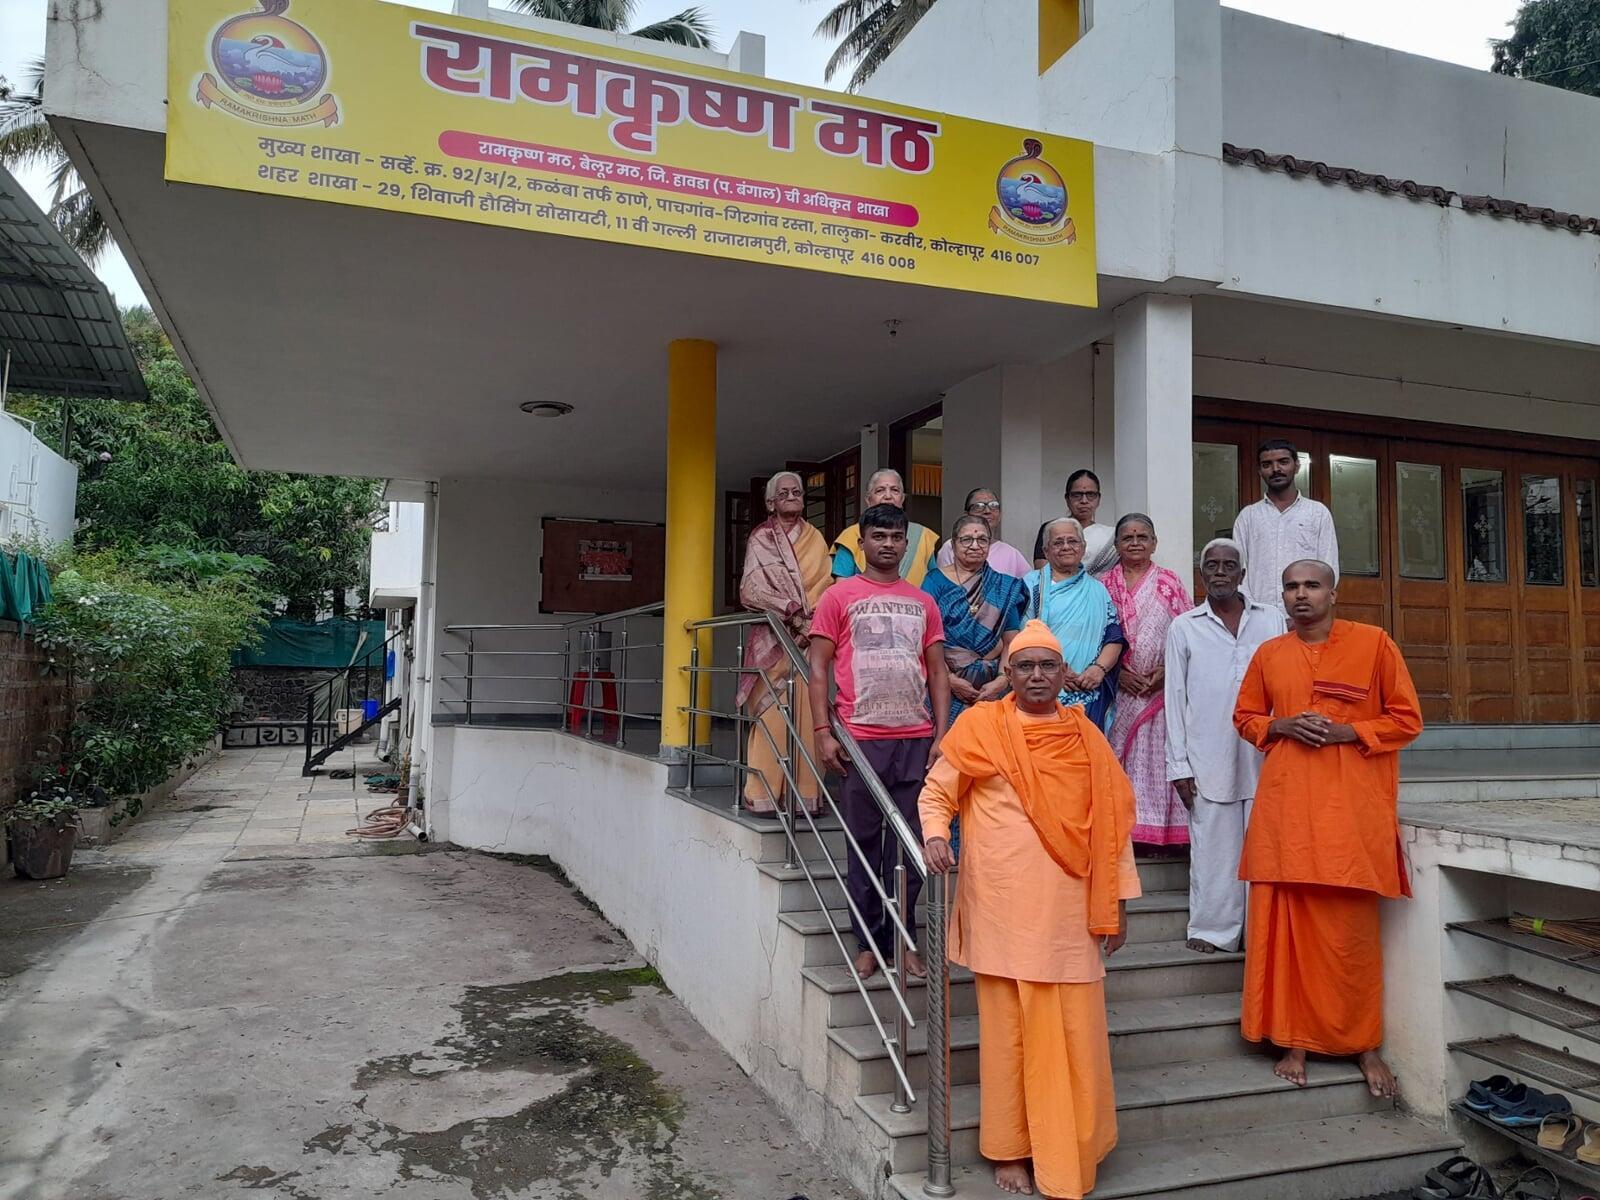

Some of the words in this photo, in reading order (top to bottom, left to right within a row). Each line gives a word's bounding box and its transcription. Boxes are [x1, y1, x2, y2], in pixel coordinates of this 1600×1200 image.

[219, 97, 289, 123] RAMAKRISHNA
[292, 111, 317, 123] MATH
[413, 24, 800, 153] रामकृष्ण
[811, 101, 939, 173] मठ
[257, 136, 306, 158] मुख्य
[310, 145, 360, 165] शाखा
[423, 161, 447, 178] क्र.
[452, 166, 522, 190] 92/अ/2,
[526, 177, 579, 198] कळंबा
[582, 185, 612, 202] तर्फ
[615, 191, 651, 211] ठाणे,
[782, 216, 817, 235] रस्ता,
[880, 231, 927, 251] करवीर,
[929, 237, 985, 262] कोल्हापूर
[990, 249, 1013, 263] 416
[1015, 252, 1040, 266] 007
[257, 164, 299, 183] शहर
[308, 172, 358, 191] शाखा
[377, 182, 405, 200] 29,
[411, 181, 475, 208] शिवाजी
[478, 192, 532, 216] हौसिंग
[536, 202, 612, 230] सोसायटी,
[615, 216, 628, 230] 11
[632, 215, 649, 232] वी
[652, 221, 697, 241] गल्ली
[703, 229, 790, 255] राजारामपुरी,
[794, 239, 855, 265] कोल्हापूर
[860, 252, 885, 266] 416
[888, 255, 916, 270] 008
[478, 141, 544, 164] रामकृष्ण
[547, 151, 576, 169] मठ,
[579, 154, 614, 179] बेलूर
[615, 163, 644, 181] मठ,
[647, 165, 669, 184] जि.
[672, 172, 710, 190] हावडा
[713, 178, 733, 195] (प.
[736, 181, 782, 203] बंगाल)
[785, 188, 800, 204] ची
[803, 192, 852, 214] अधिकृत
[856, 202, 890, 218] शाखा
[855, 600, 924, 617] WANTED
